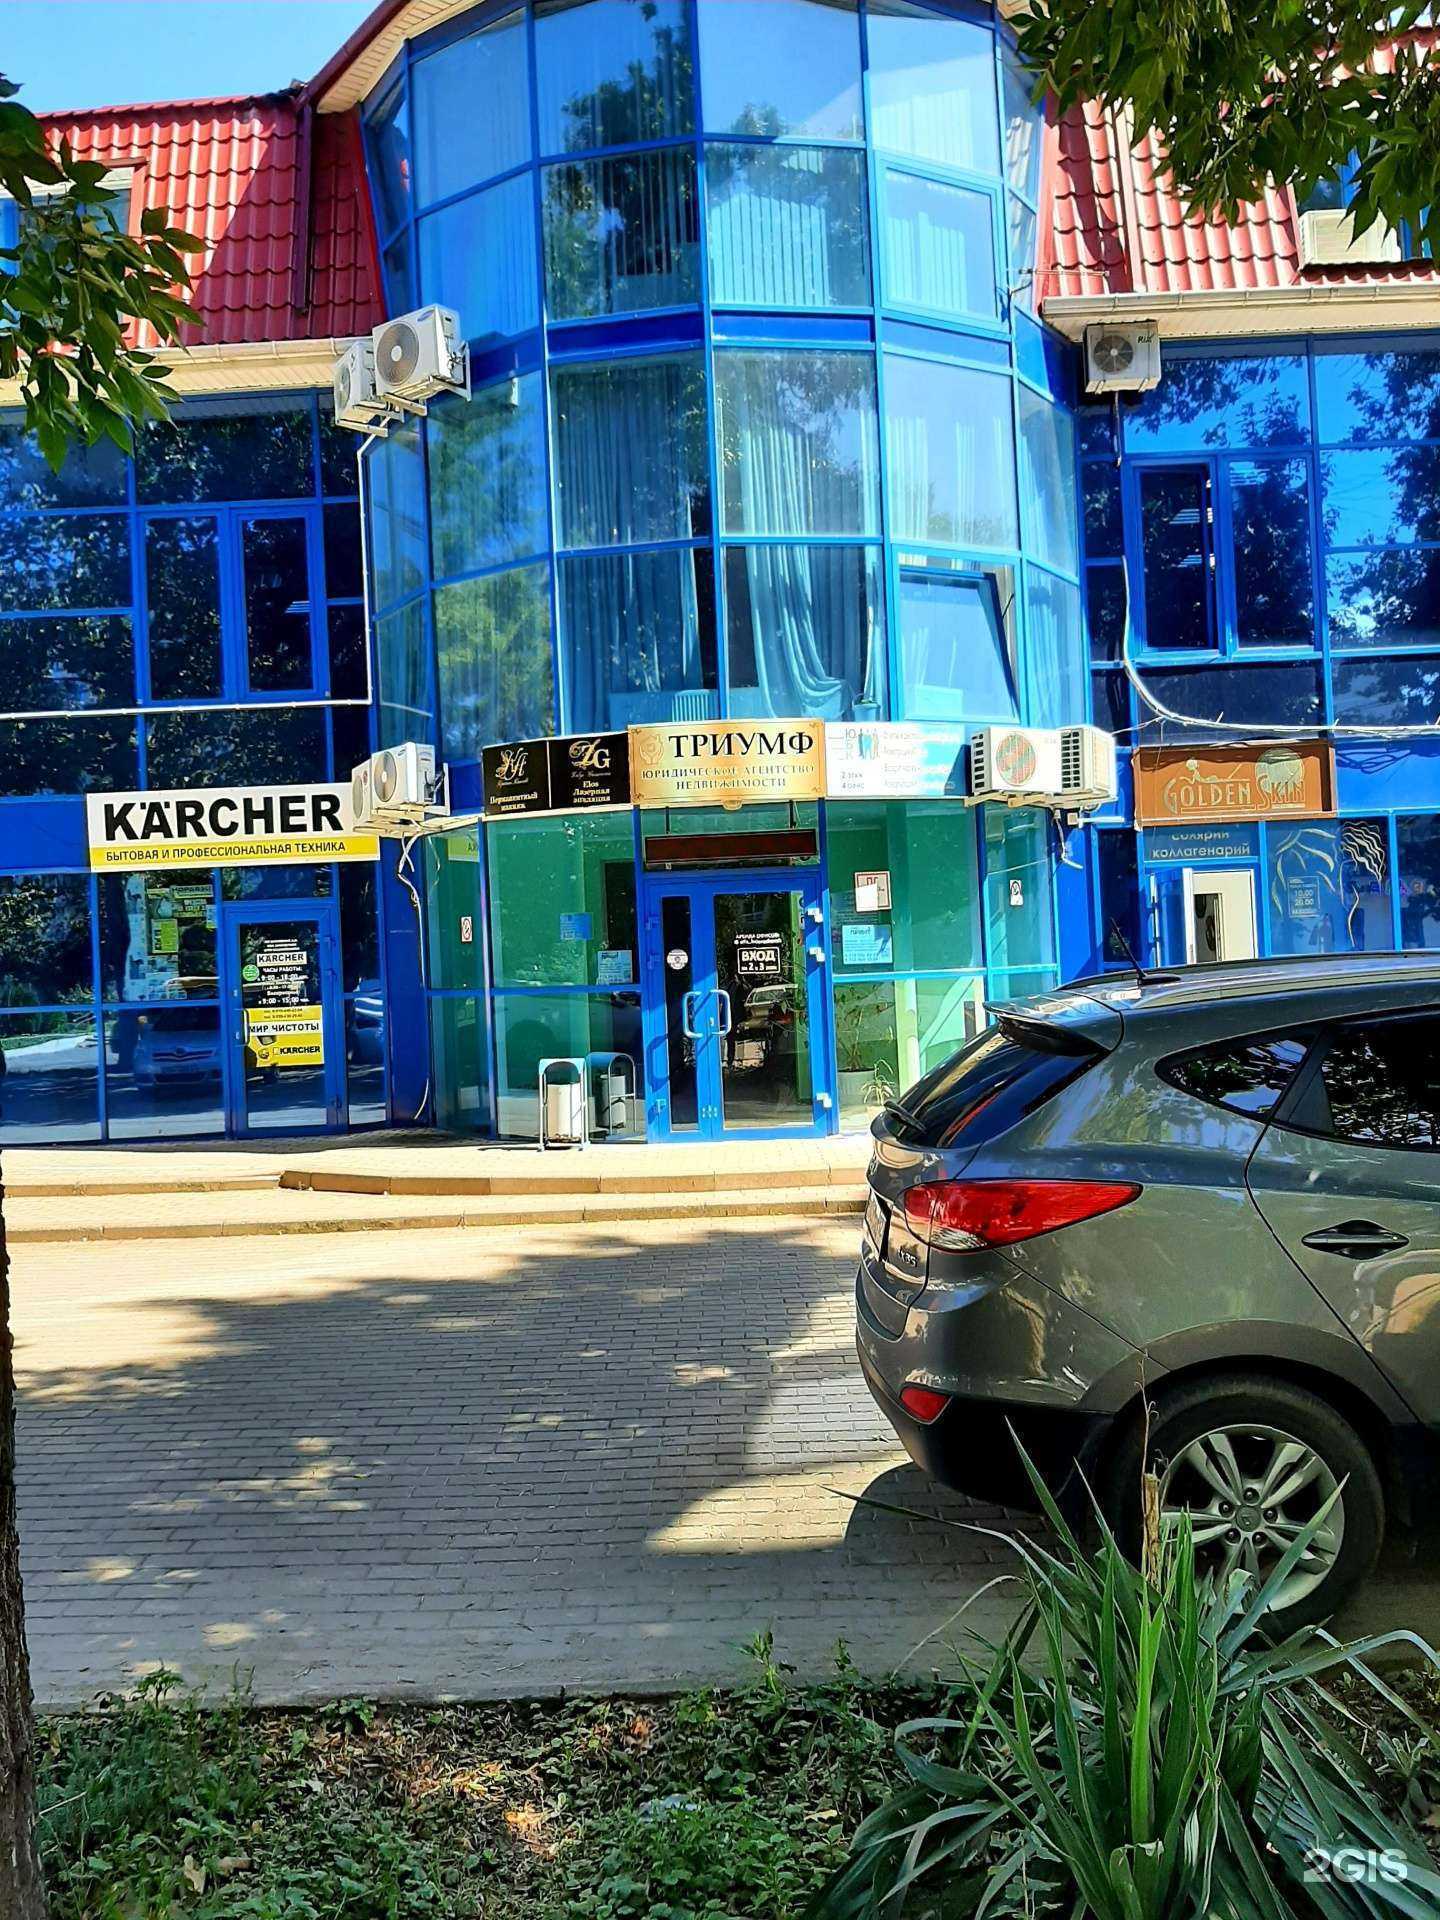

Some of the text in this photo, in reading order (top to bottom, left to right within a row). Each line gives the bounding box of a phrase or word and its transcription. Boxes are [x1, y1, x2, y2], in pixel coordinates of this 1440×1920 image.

[668, 731, 814, 758] ТРИУМФ
[642, 767, 736, 779] ЮРИДИЧЕСКОЕ
[582, 780, 599, 788] Elos
[676, 778, 786, 790] НЕДВИЖИМОСТИ
[103, 793, 343, 841] KÄRCHER
[105, 840, 346, 862] БЫТОВАЯ И ПРОФЕССИОНАЛЬНАЯ ТЕХНИКА
[1152, 842, 1250, 858] коллагенарий
[741, 950, 776, 962] ВХОД
[271, 1022, 319, 1032] ЧИСТОТЫ
